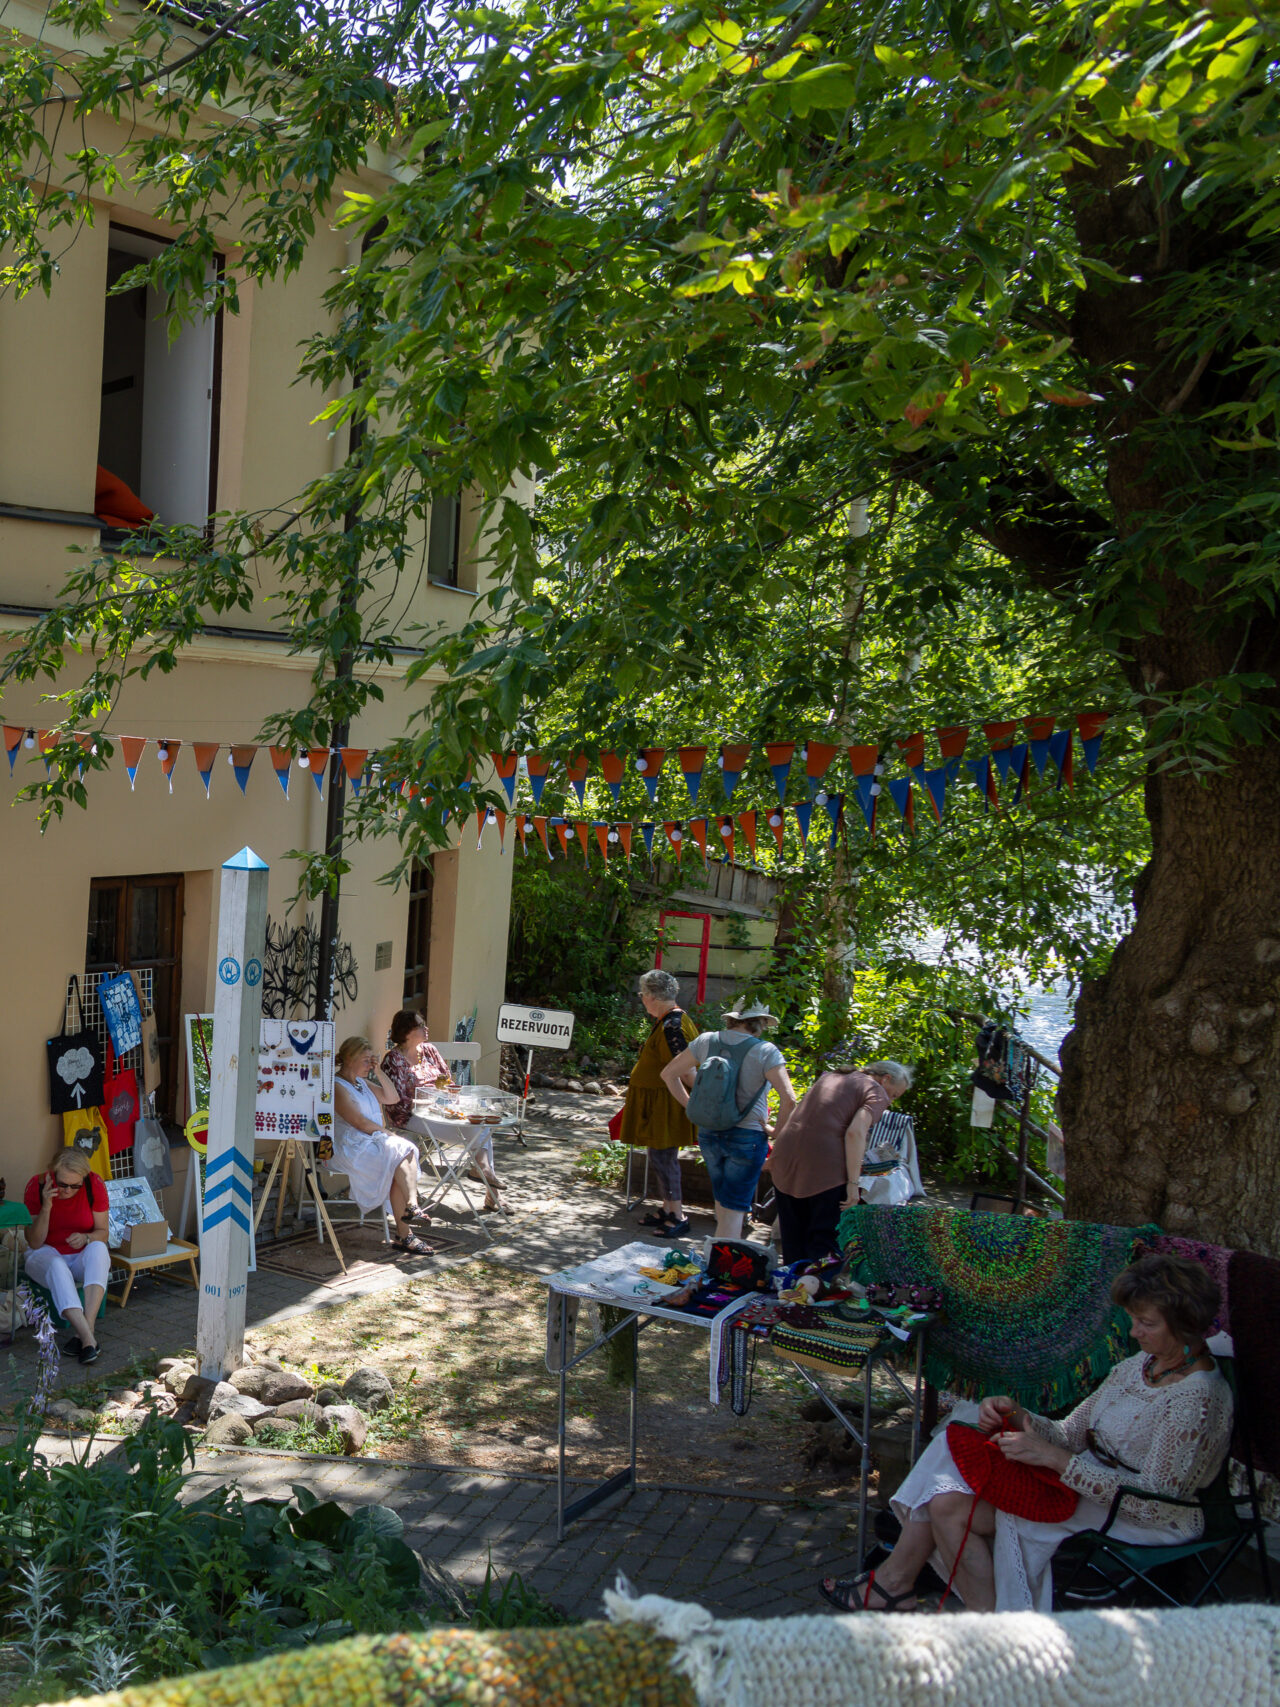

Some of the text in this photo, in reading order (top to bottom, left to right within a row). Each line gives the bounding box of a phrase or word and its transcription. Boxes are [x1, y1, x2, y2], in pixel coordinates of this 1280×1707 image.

[501, 1018, 570, 1037] REZERVUOTA
[205, 1284, 221, 1297] 001
[228, 1284, 246, 1299] 1997
